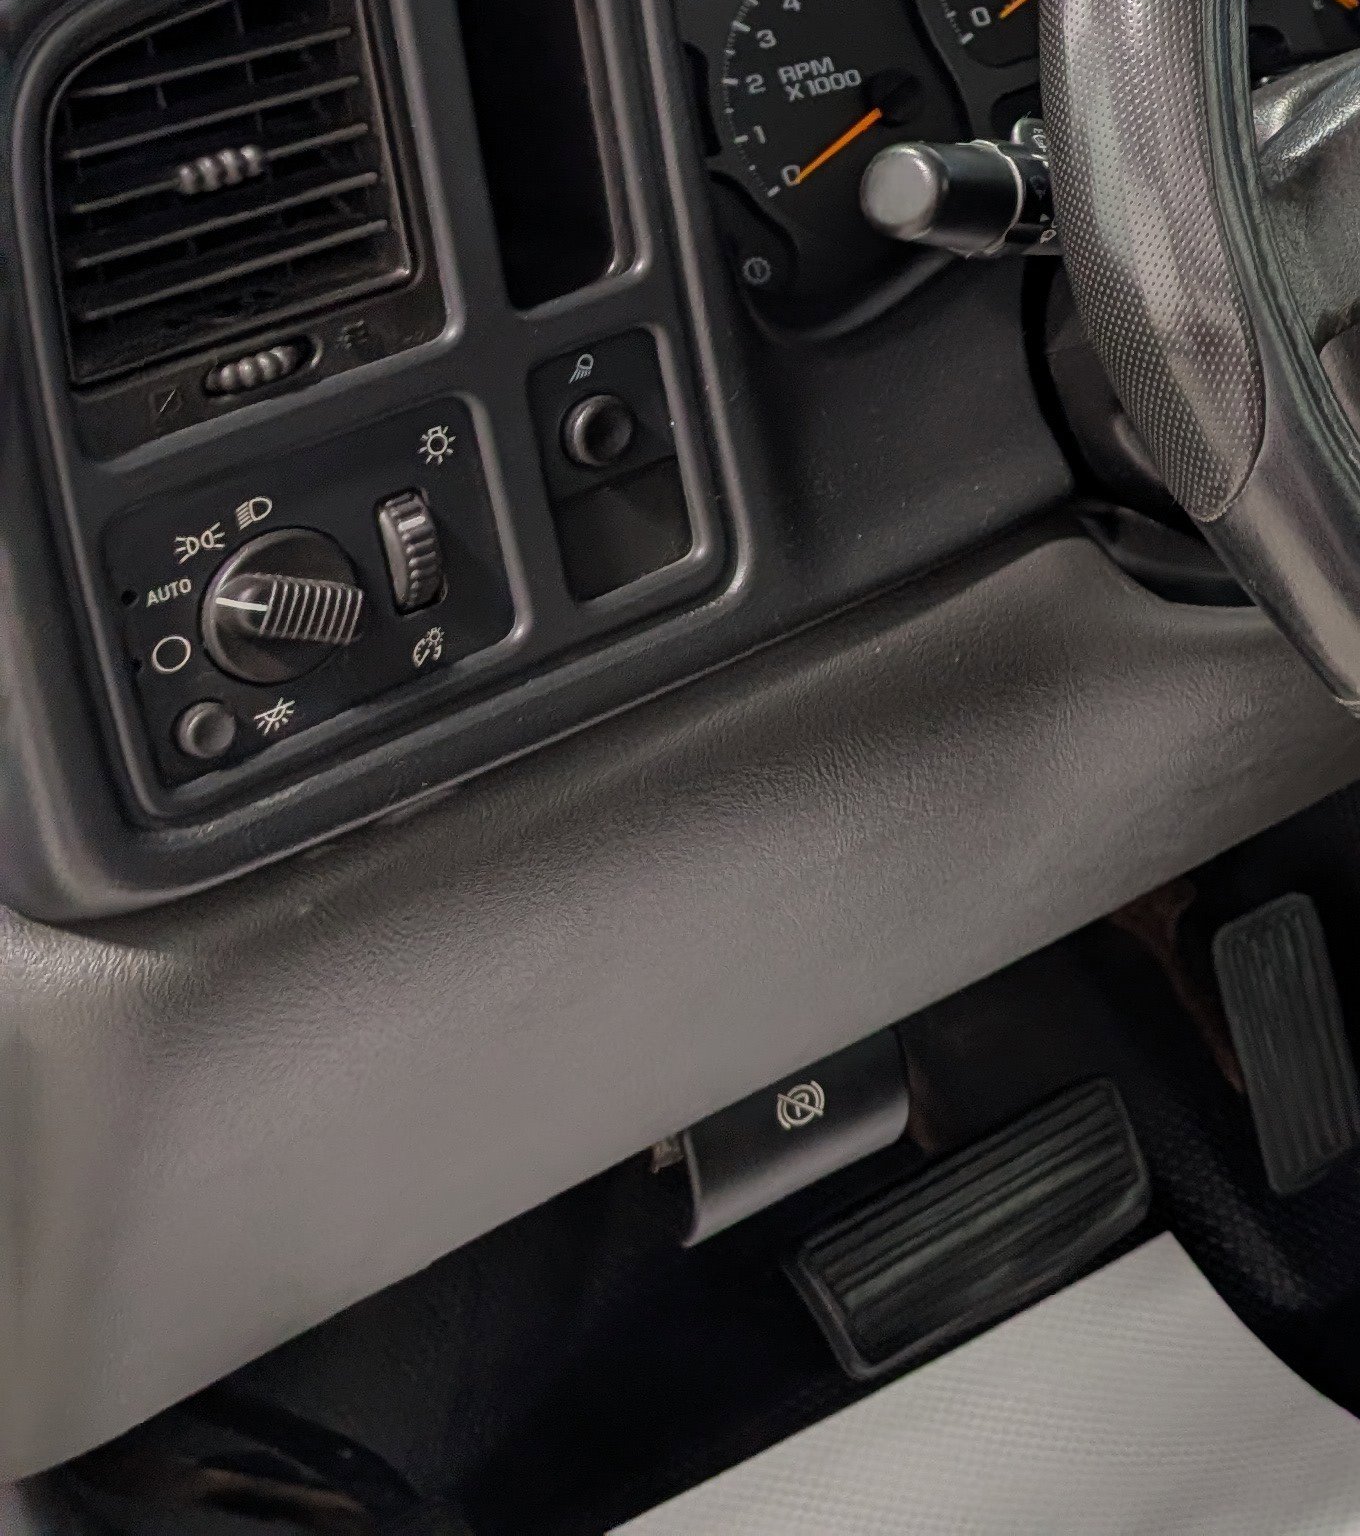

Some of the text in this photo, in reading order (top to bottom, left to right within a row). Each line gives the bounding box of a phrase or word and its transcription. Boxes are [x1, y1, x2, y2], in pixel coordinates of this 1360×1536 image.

[971, 7, 992, 27] 0
[756, 29, 777, 49] 3
[778, 56, 835, 84] RPM
[745, 73, 766, 95] 2
[753, 125, 767, 144] 1
[780, 164, 801, 187] 0
[146, 578, 192, 608] AUTO
